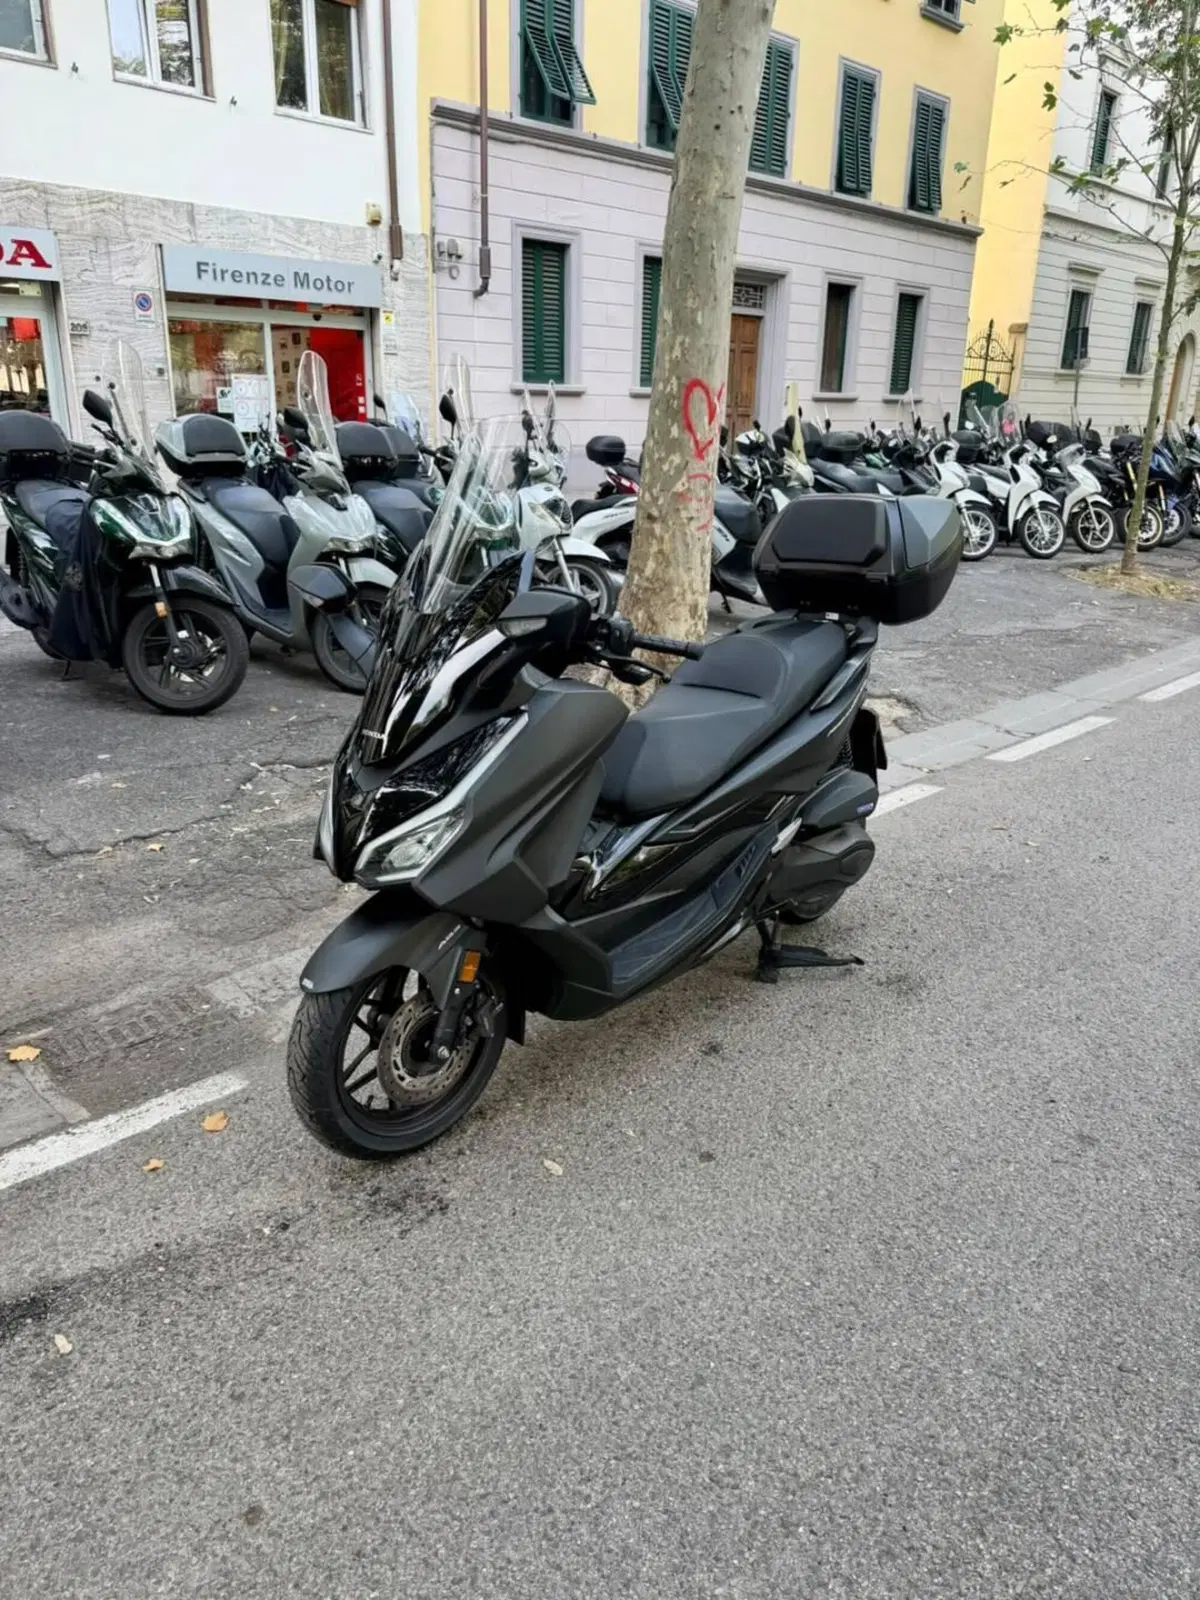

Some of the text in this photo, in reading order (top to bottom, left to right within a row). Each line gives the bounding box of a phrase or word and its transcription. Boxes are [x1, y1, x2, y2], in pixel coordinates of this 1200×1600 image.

[0, 239, 52, 268] A
[196, 261, 355, 294] Firenze Motor
